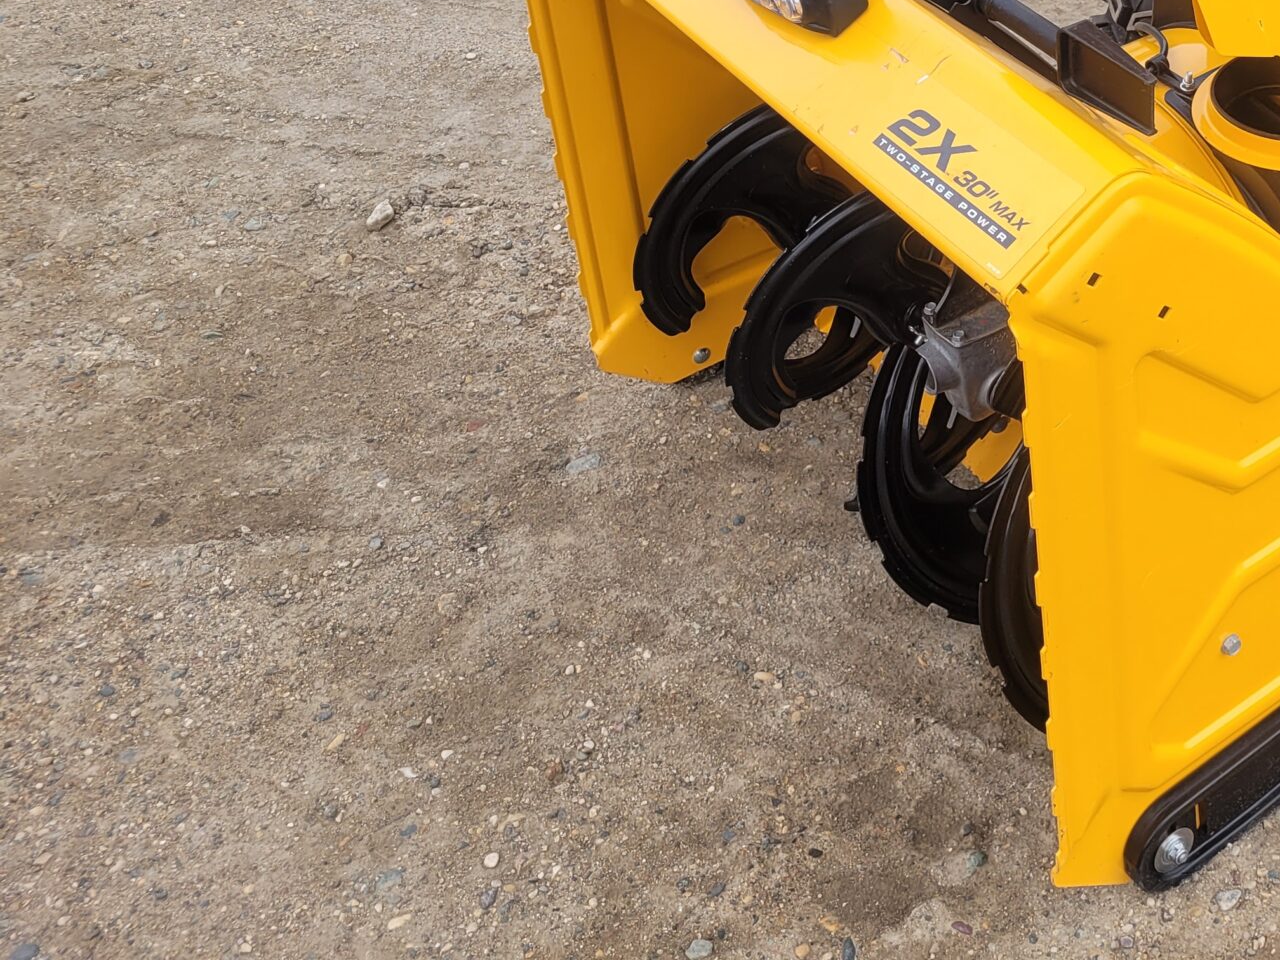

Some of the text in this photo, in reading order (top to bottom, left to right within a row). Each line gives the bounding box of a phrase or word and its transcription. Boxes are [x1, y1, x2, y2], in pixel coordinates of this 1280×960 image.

[878, 137, 1008, 244] TWO-STAGE POWER
[887, 109, 979, 173] 2X
[989, 200, 1031, 231] MAX
